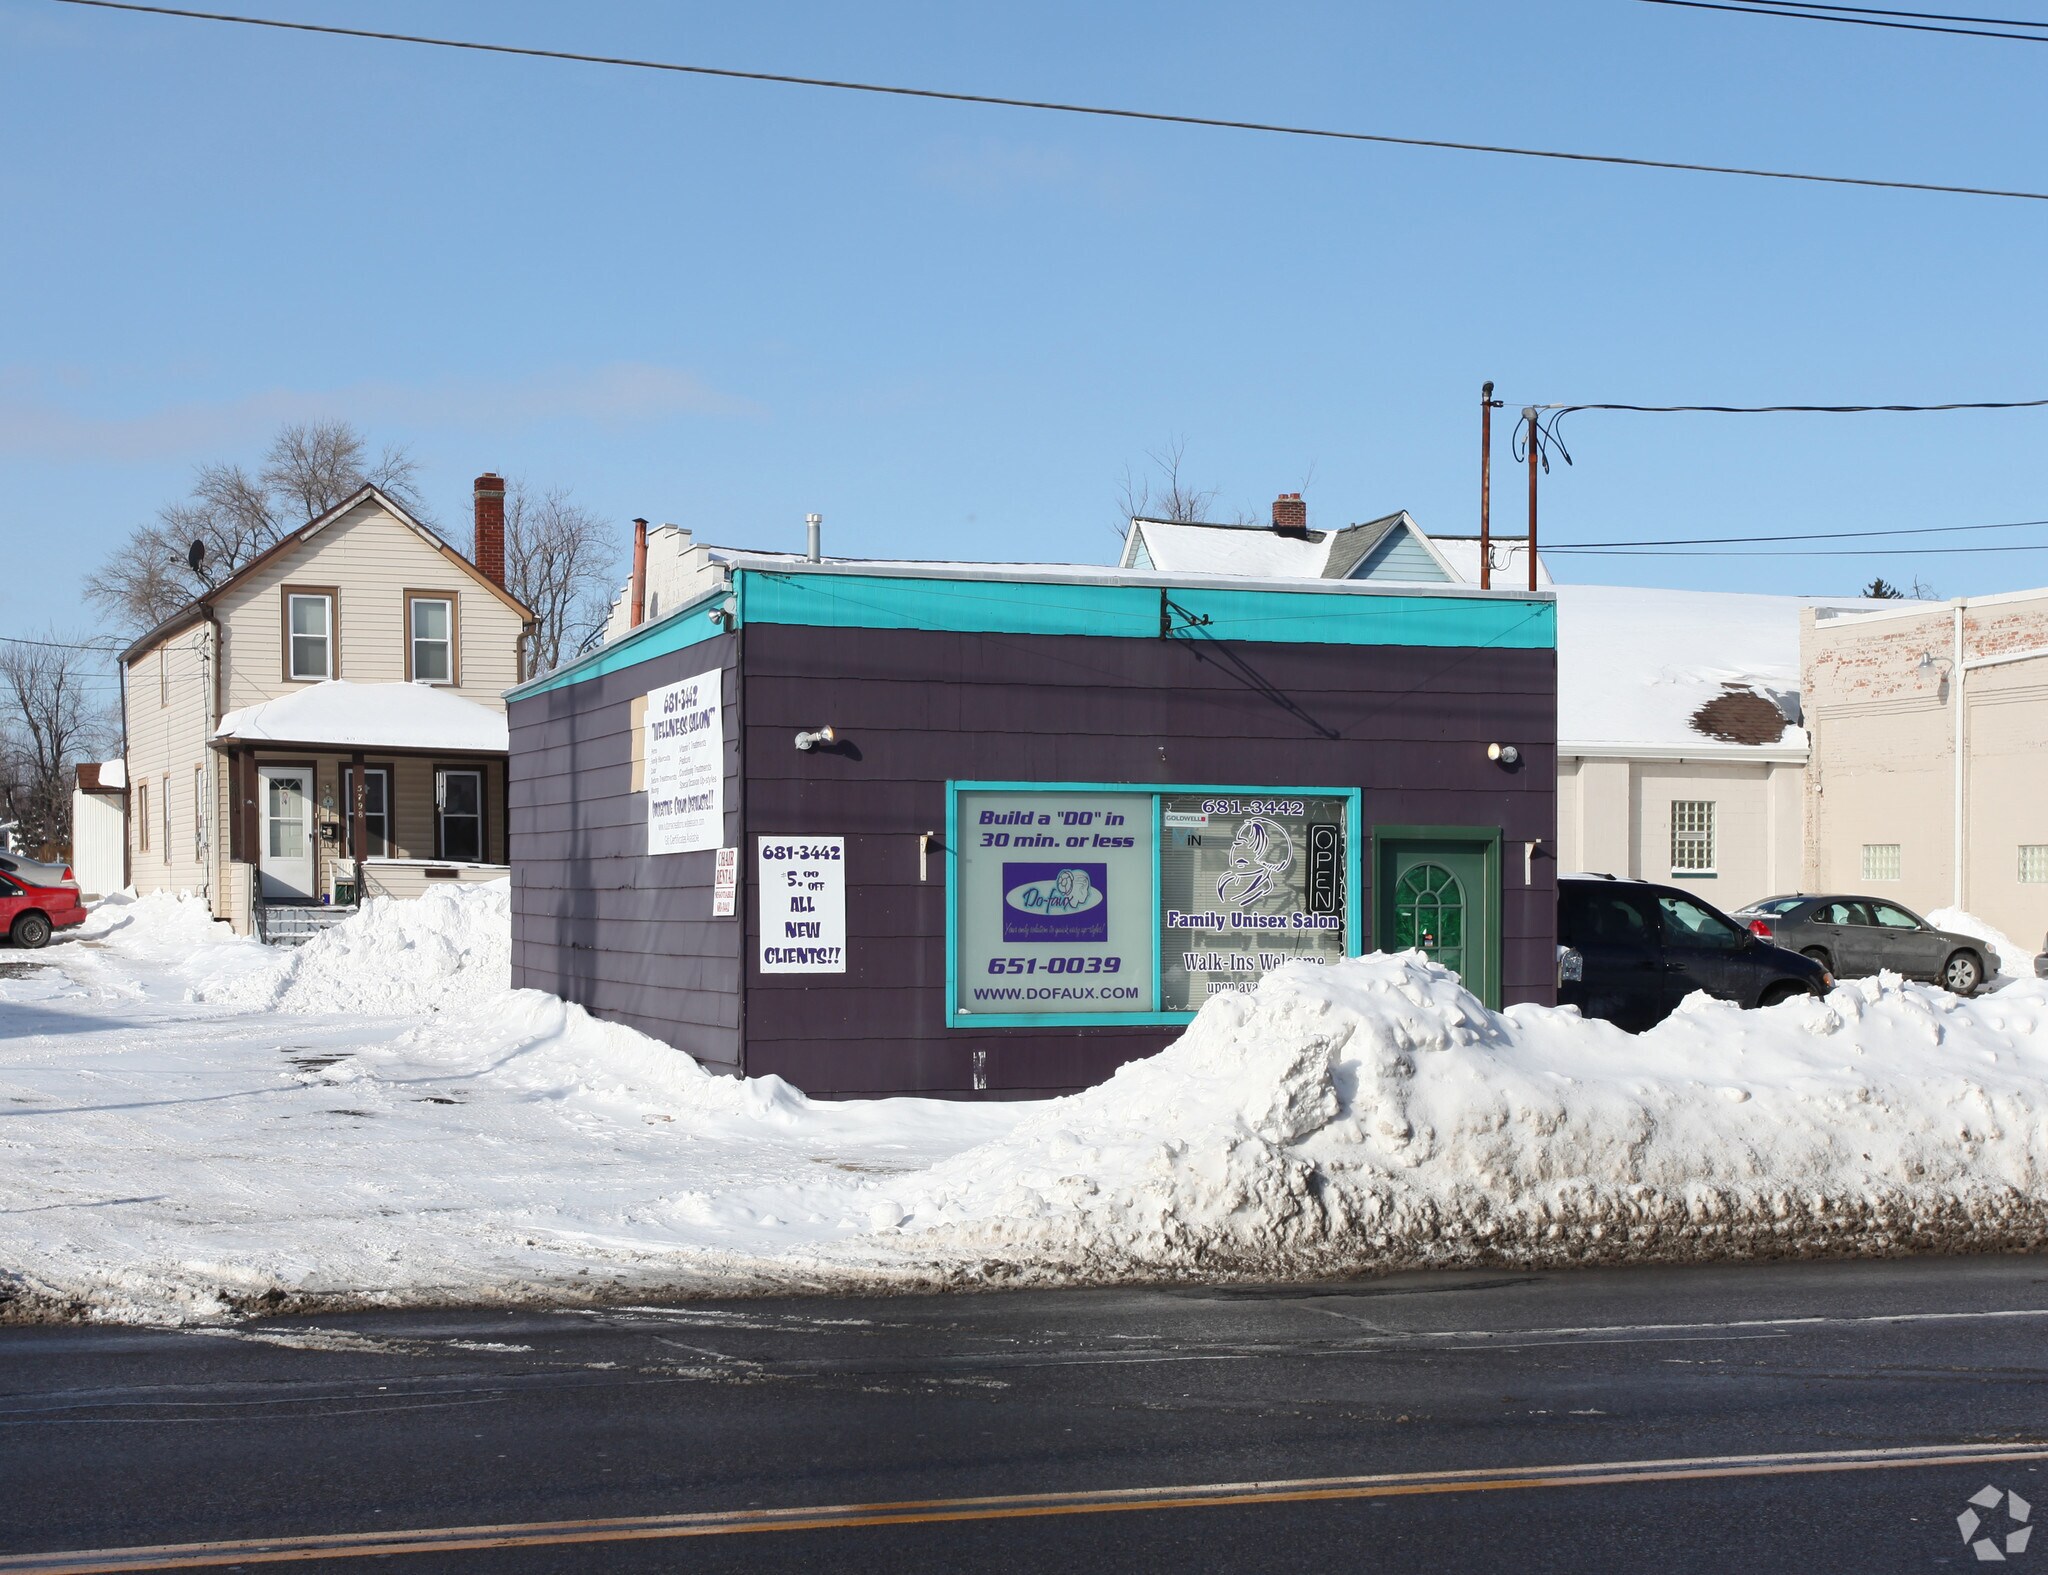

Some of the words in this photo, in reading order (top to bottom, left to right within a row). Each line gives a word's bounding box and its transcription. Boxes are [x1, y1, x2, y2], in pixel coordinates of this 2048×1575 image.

[664, 685, 698, 714] 681-3442
[1201, 799, 1304, 816] 681-3442
[979, 810, 1034, 826] Build
[1037, 814, 1051, 826] a
[1057, 811, 1101, 826] "DO"
[1104, 812, 1125, 826] in
[979, 833, 1010, 848] 30
[1013, 833, 1060, 848] min.
[1065, 836, 1090, 848] or
[1092, 834, 1135, 848] less
[718, 851, 734, 866] CHAIR
[762, 845, 841, 860] 681-3442
[716, 869, 734, 884] RENTAL
[1315, 830, 1333, 908] OPEN
[808, 882, 825, 891] OFF
[790, 897, 815, 912] ALL
[1023, 888, 1077, 913] Do-faux
[1168, 911, 1226, 931] Family
[1231, 912, 1287, 929] Unisex
[1292, 912, 1340, 929] Salon
[785, 922, 821, 938] NEW
[764, 947, 841, 964] CLIENTS!!
[1183, 953, 1254, 971] Walk-Ins
[1260, 953, 1325, 971] Welme
[988, 957, 1122, 974] 651-0039
[974, 987, 1139, 1000] WWW.DOFAUX.COM
